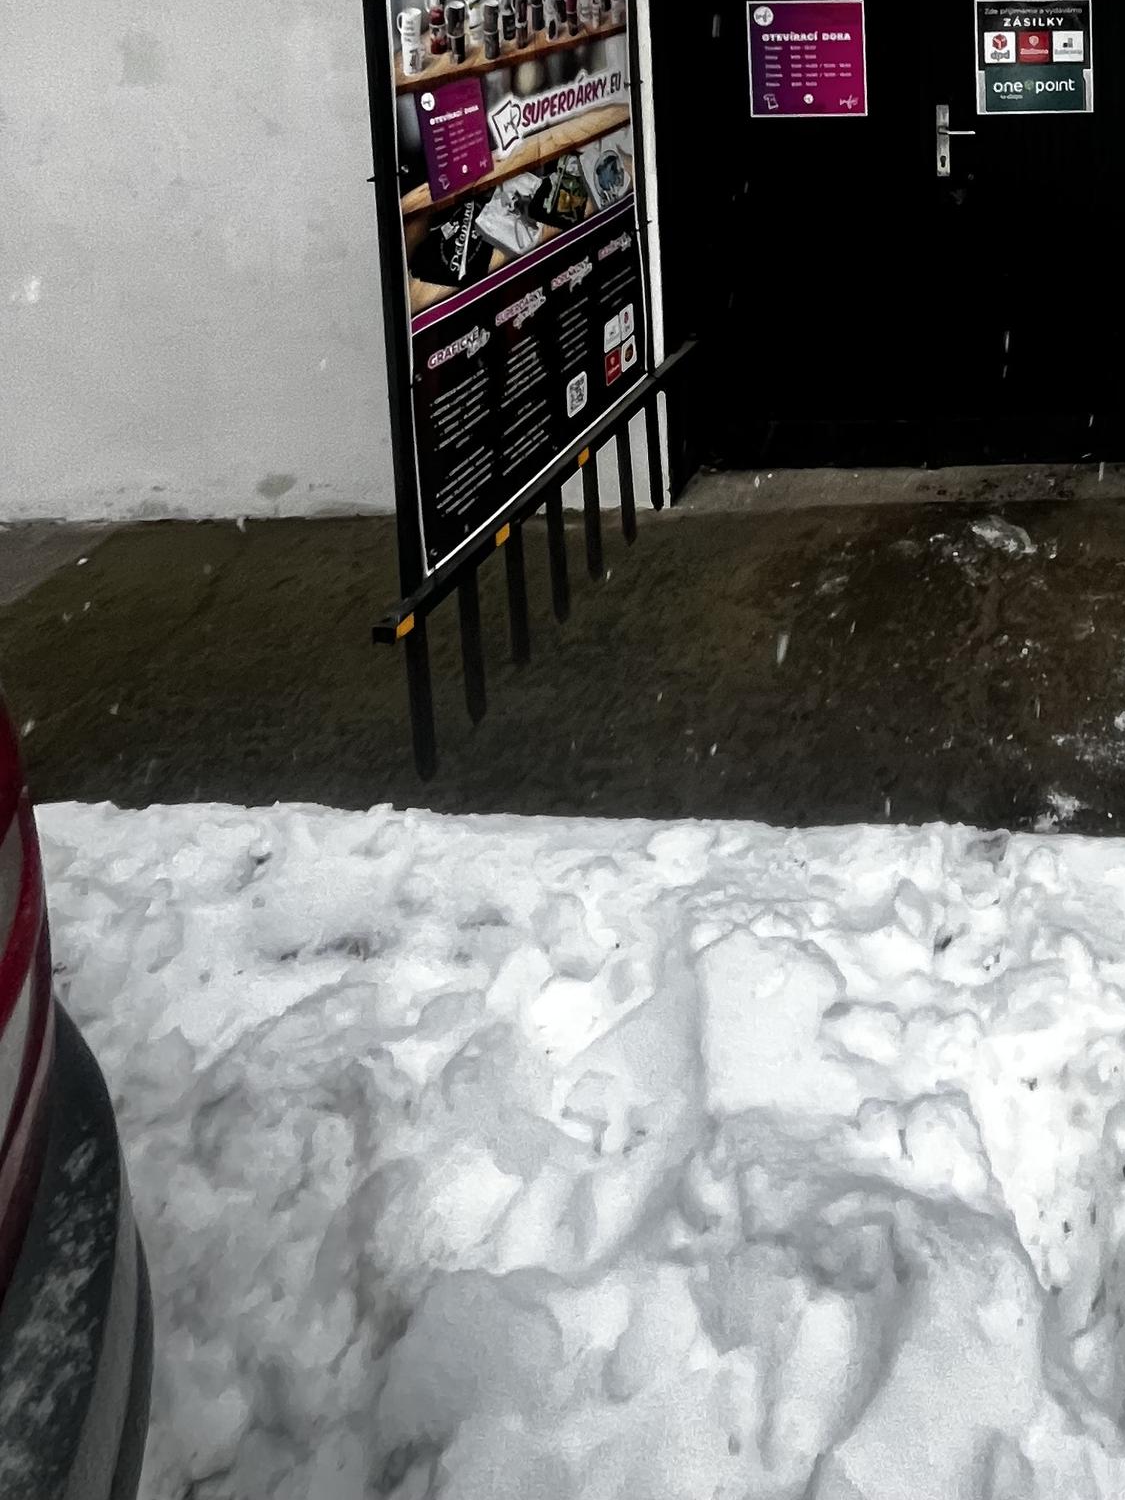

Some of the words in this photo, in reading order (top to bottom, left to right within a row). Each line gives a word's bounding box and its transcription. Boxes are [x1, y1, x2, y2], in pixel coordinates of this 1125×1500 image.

[1003, 15, 1064, 27] ZÁSILKY
[990, 50, 1010, 61] dpd
[993, 82, 1023, 93] one
[1035, 78, 1075, 94] point
[521, 71, 622, 128] SUPERDÁRKY.EU
